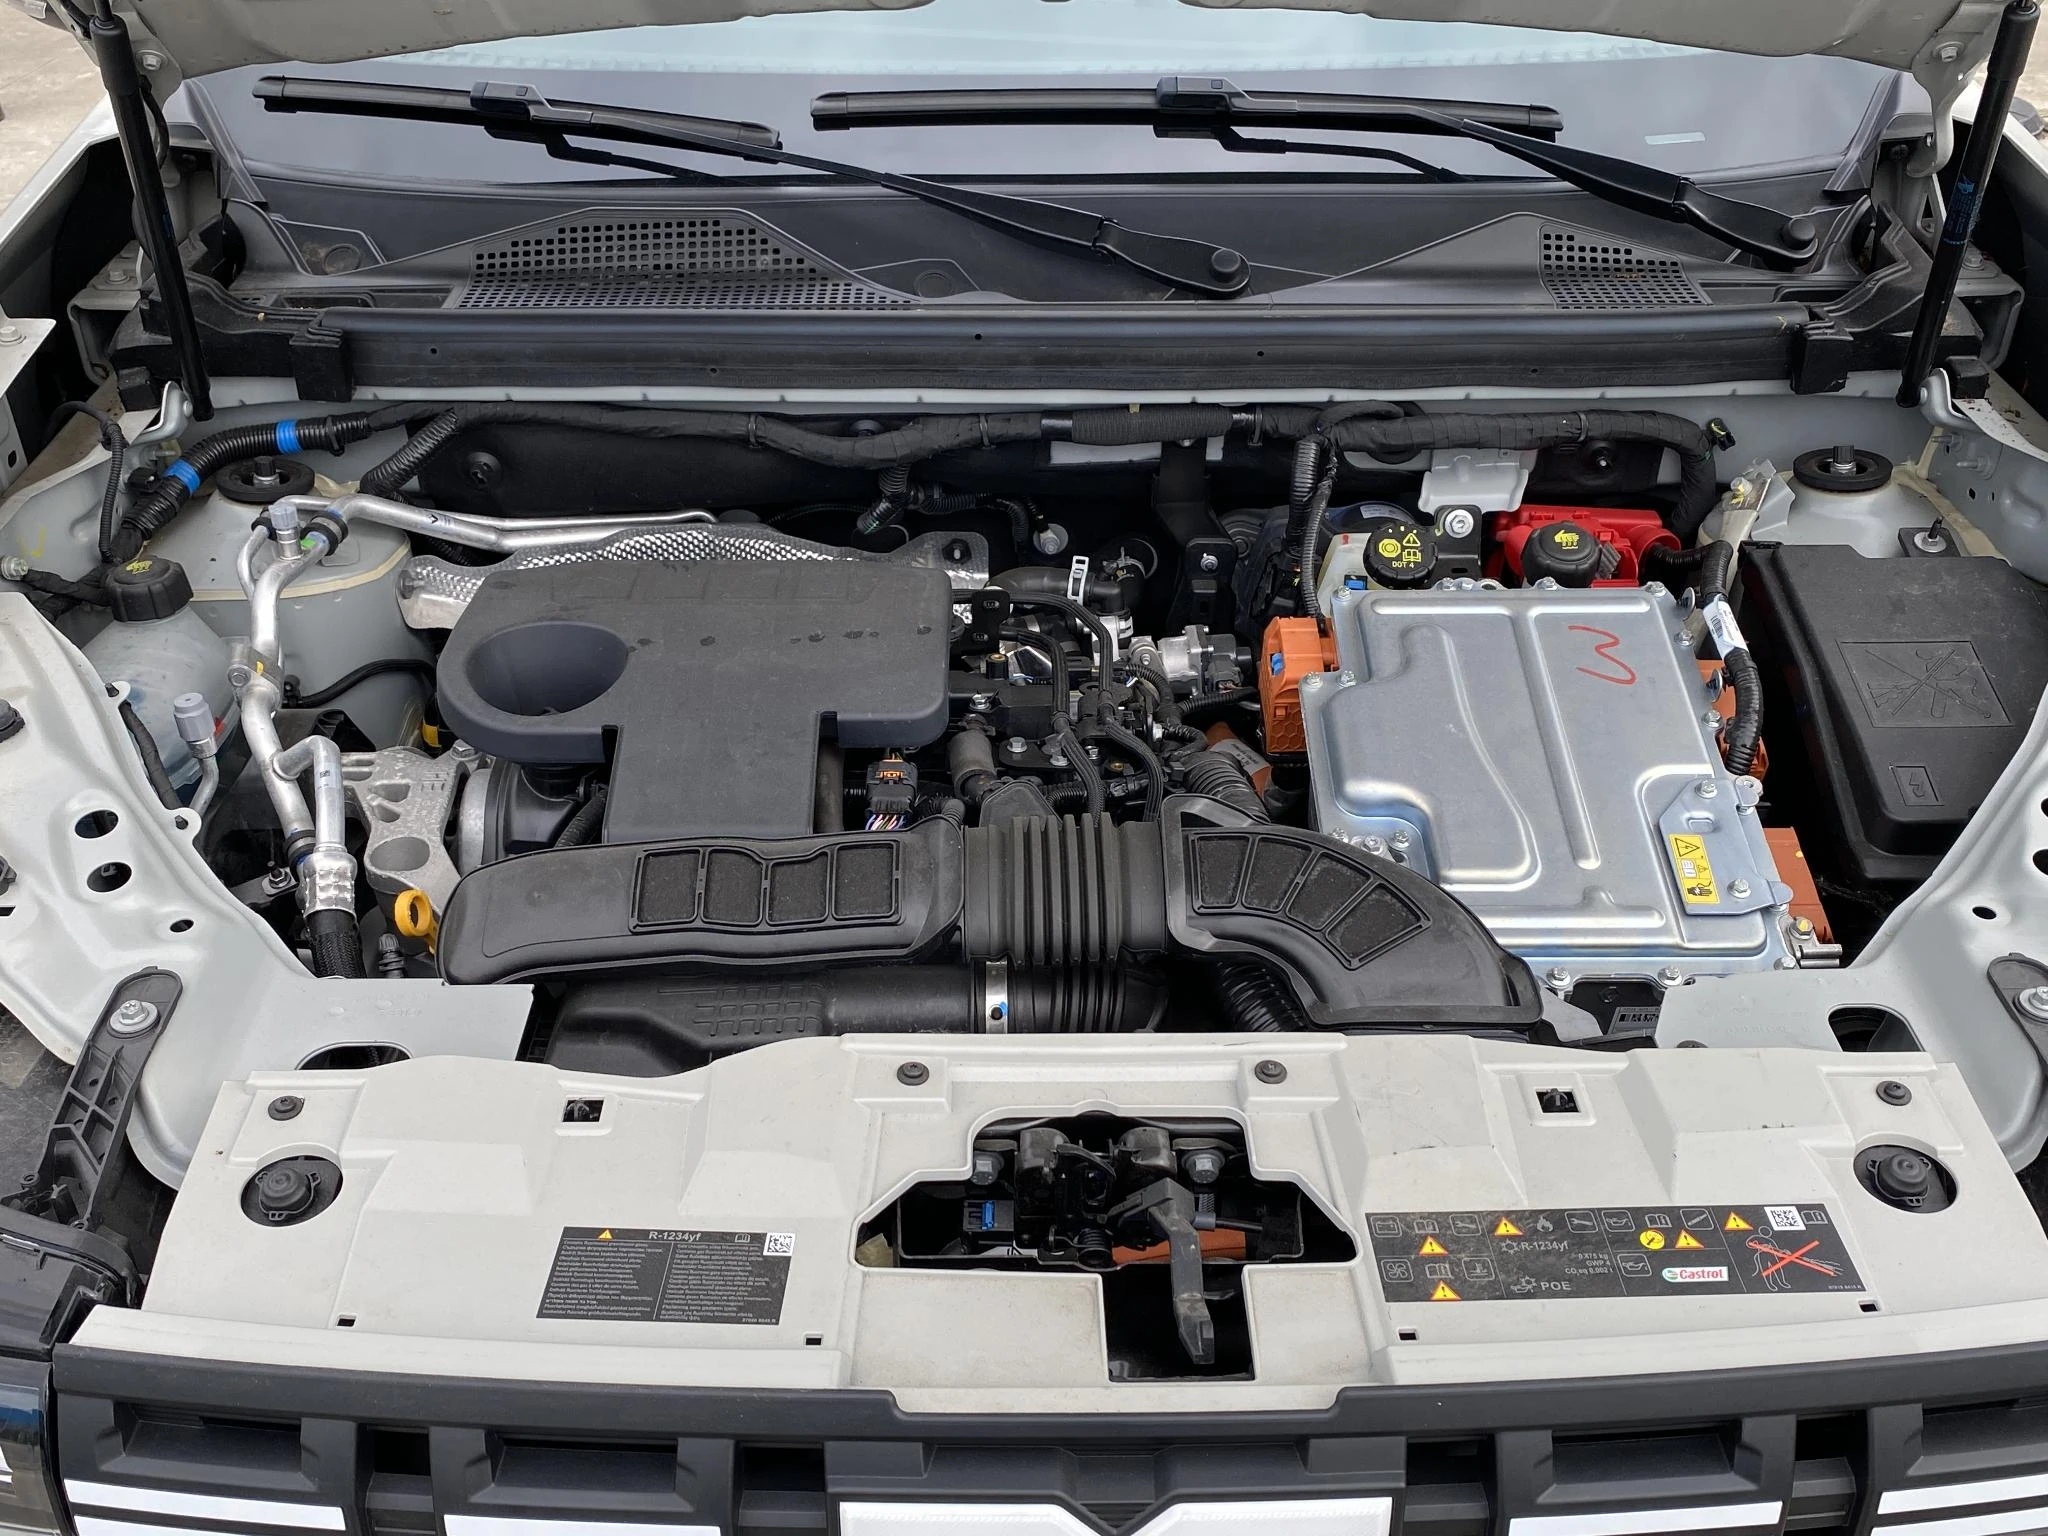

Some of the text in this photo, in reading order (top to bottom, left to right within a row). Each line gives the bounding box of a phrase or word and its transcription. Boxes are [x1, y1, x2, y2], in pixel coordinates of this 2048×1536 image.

[648, 1231, 702, 1244] R-1234yf
[1521, 1240, 1569, 1252] R-1234yf
[1680, 1269, 1725, 1279] Castrol
[1540, 1281, 1572, 1290] POE
